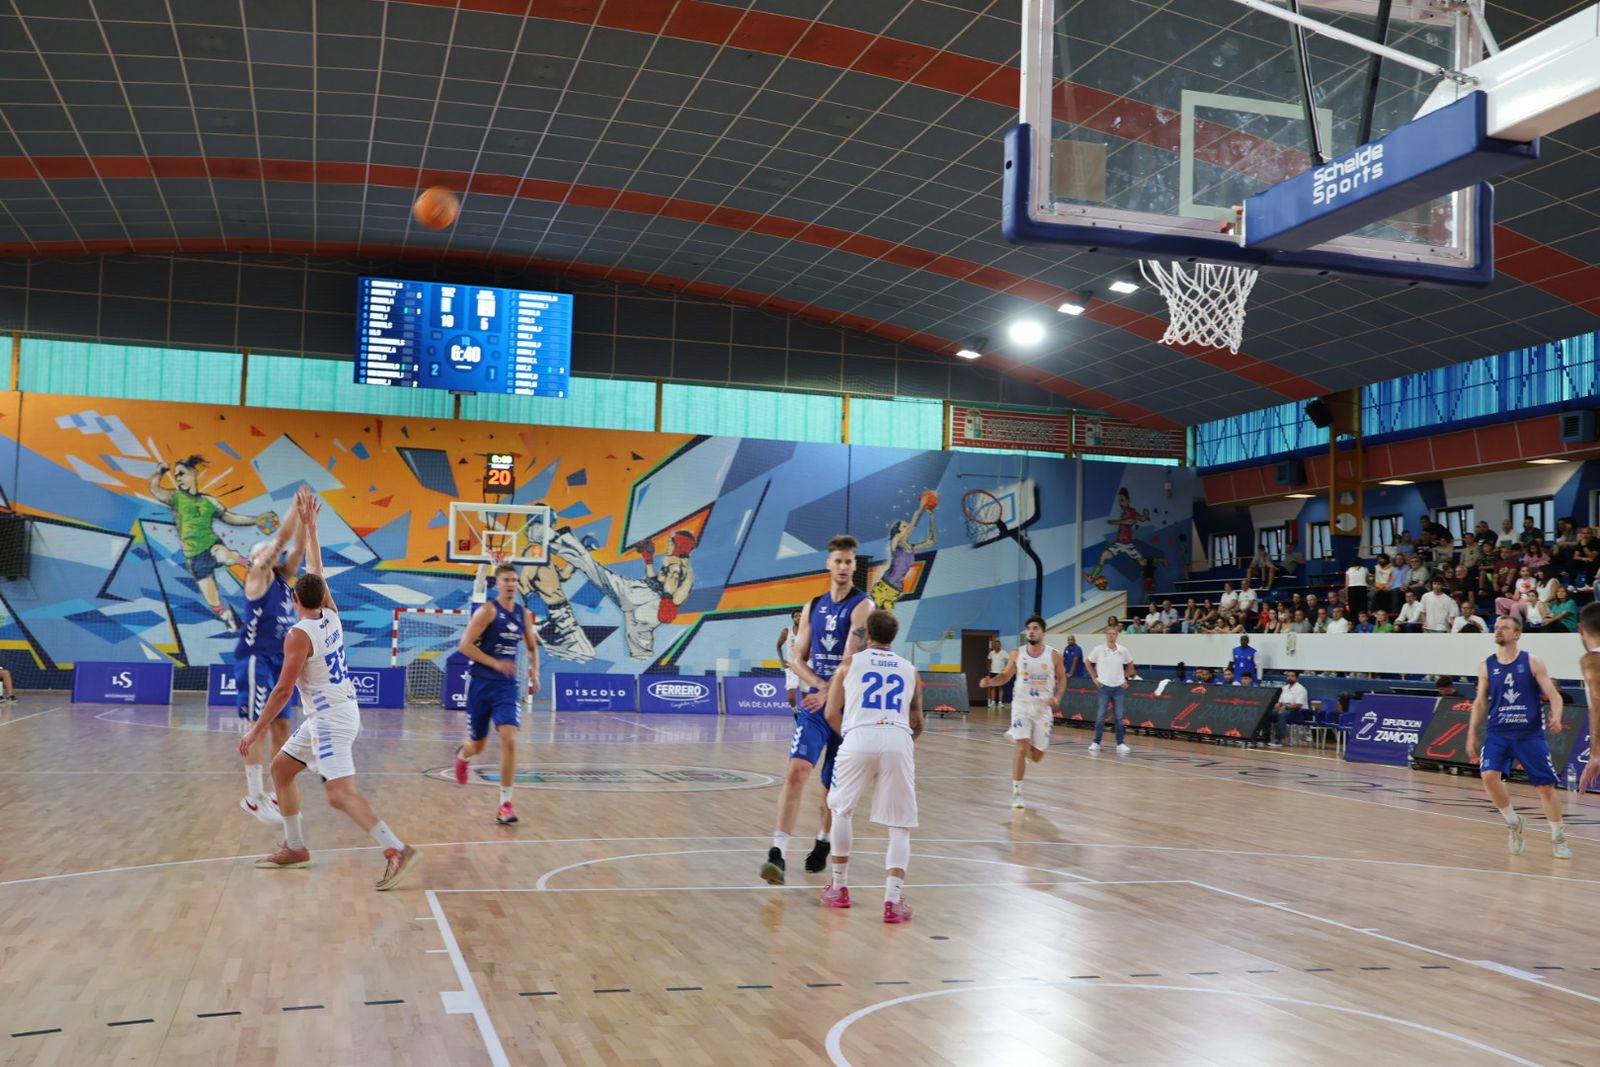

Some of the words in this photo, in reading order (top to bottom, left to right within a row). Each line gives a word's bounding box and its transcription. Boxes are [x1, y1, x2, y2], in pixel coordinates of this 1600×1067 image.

[1313, 144, 1383, 187] Schelde
[1313, 163, 1383, 205] Sports
[480, 317, 489, 330] 5
[451, 344, 481, 362] 6:40
[431, 364, 439, 376] 2
[489, 368, 496, 380] 1
[488, 469, 511, 486] 20
[825, 614, 838, 631] 16
[1504, 673, 1514, 687] 4
[565, 688, 626, 697] DISCOLO
[655, 684, 702, 697] FERRERO
[861, 671, 905, 713] 22
[1373, 730, 1419, 745] ZAMORA
